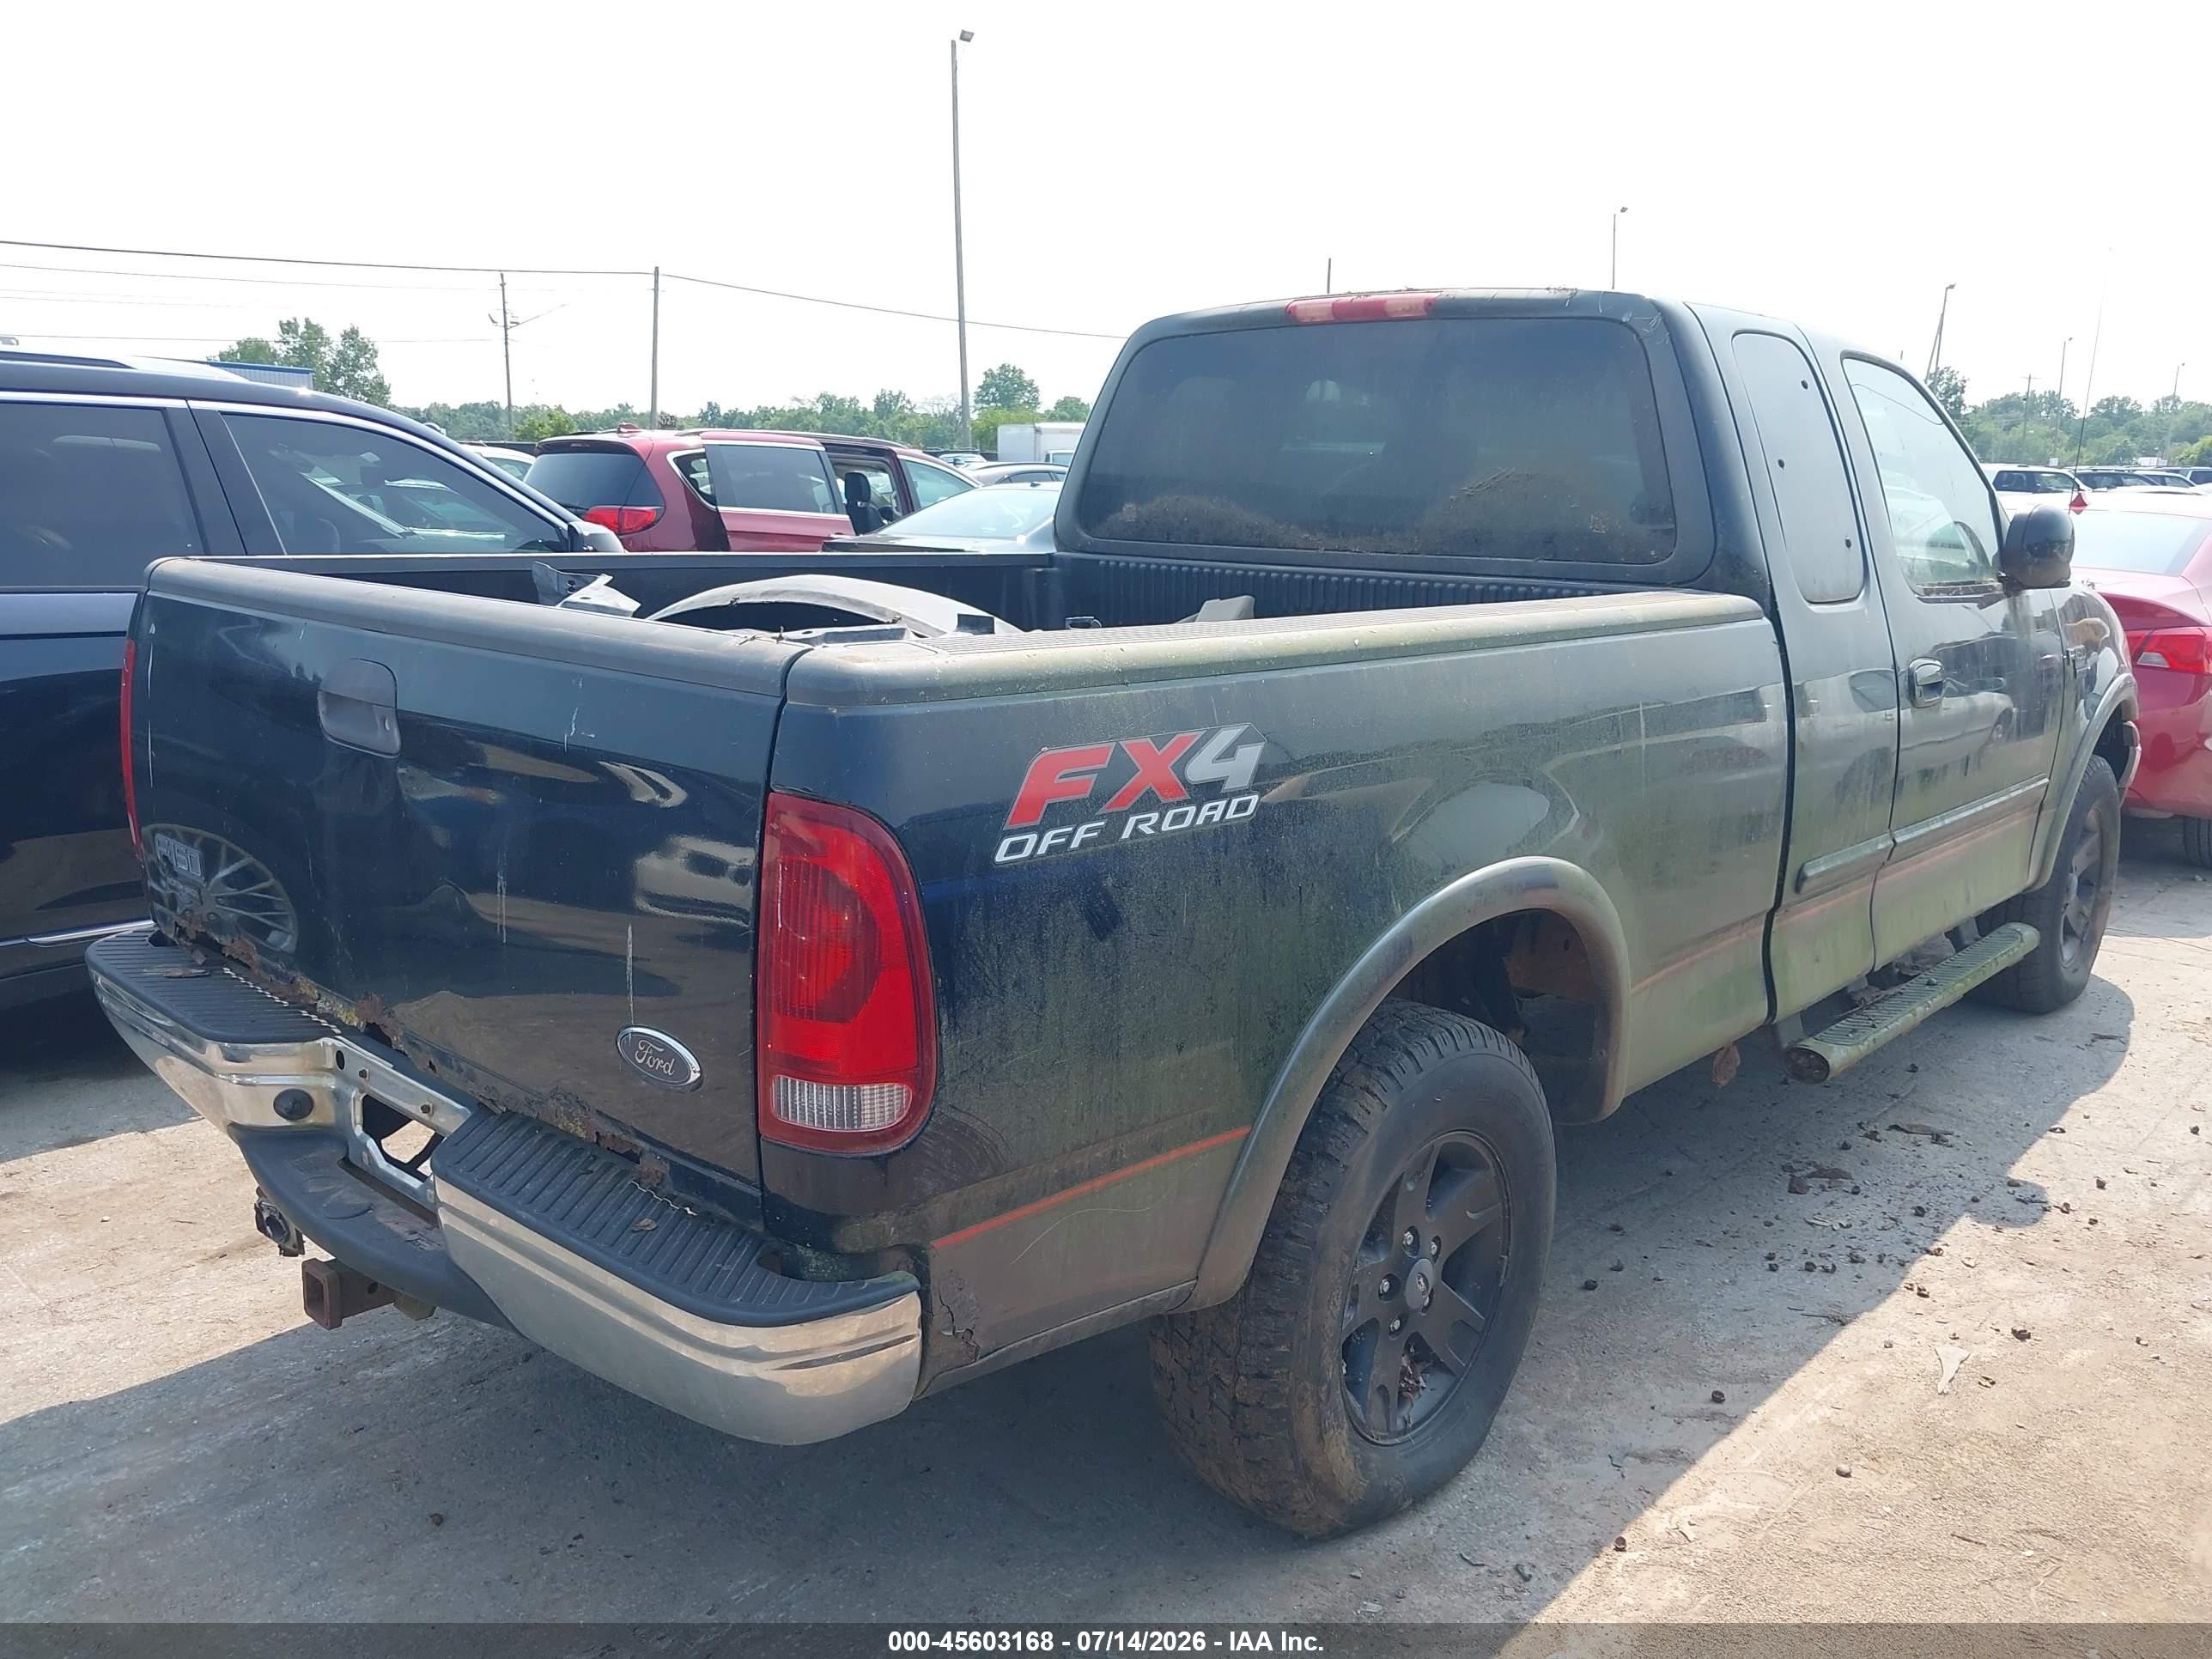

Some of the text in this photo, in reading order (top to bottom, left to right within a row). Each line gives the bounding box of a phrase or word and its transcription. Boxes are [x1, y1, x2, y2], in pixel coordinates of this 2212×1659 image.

[1003, 724, 1266, 830] FX4
[994, 794, 1260, 863] OFF ROAD
[635, 1040, 675, 1075] Ford
